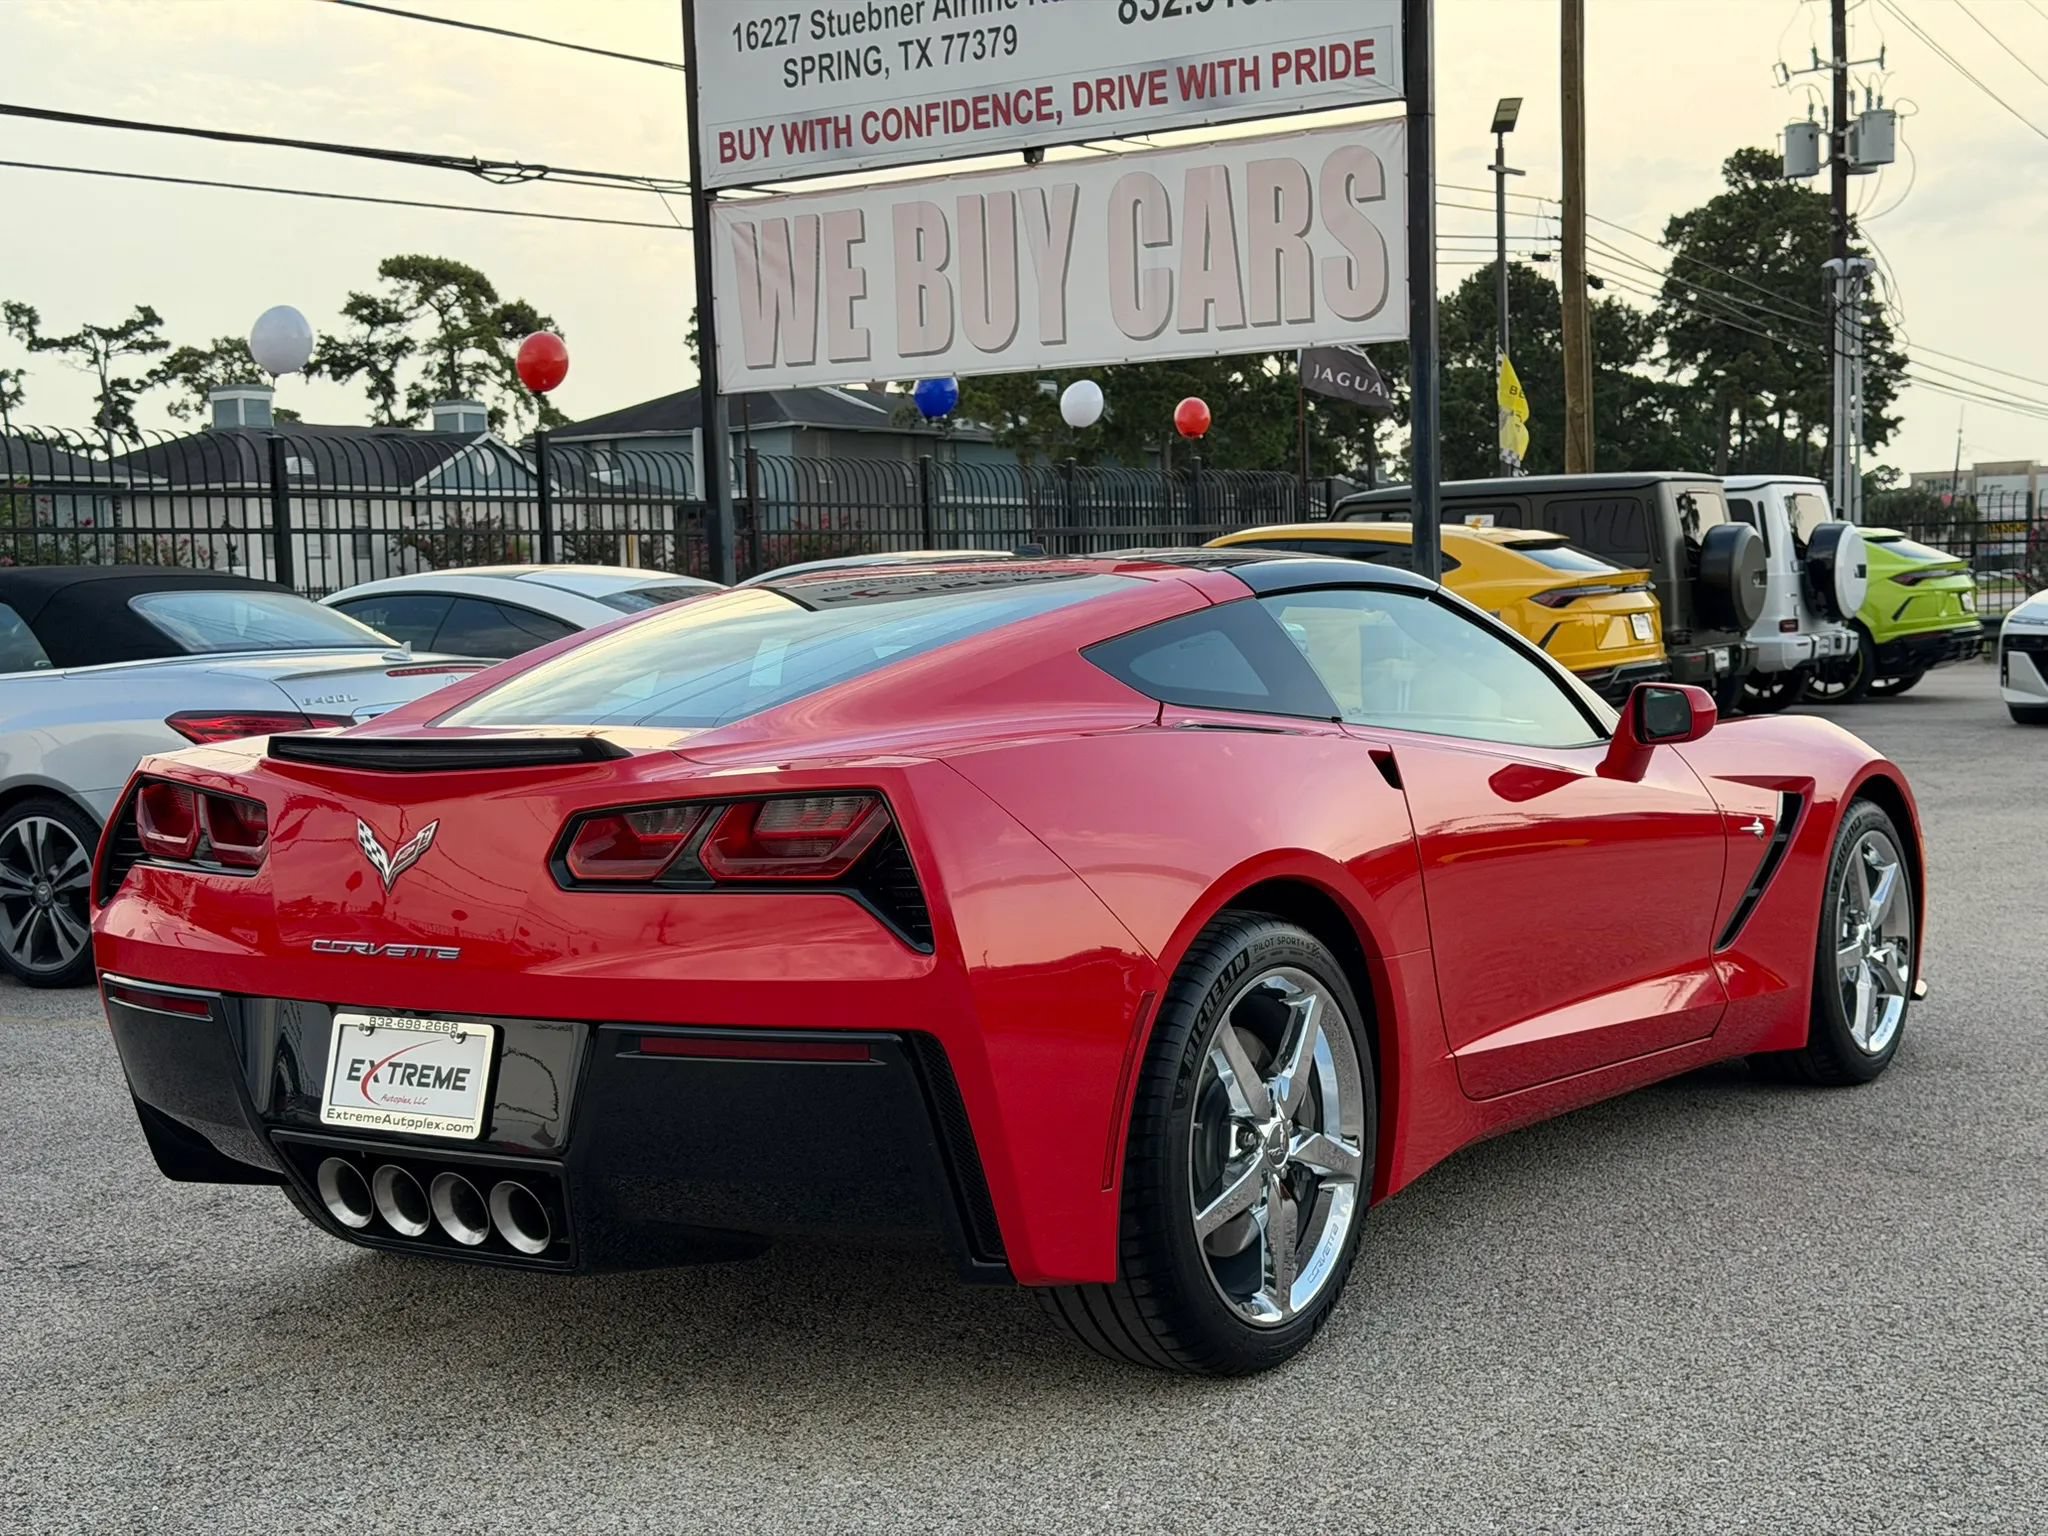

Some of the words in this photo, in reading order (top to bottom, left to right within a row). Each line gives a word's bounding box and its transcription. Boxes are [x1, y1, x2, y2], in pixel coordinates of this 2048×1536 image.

[732, 14, 801, 53] 16227
[810, 0, 926, 41] Stuebner
[783, 45, 890, 88] SPRING,
[898, 37, 933, 71] TX
[941, 24, 1018, 66] 77379
[718, 124, 774, 164] BUY
[780, 114, 853, 156] WITH
[861, 86, 1063, 146] CONFIDENCE,
[1072, 70, 1168, 117] DRIVE
[1177, 56, 1260, 101] WITH
[1271, 39, 1375, 88] PRIDE
[731, 208, 870, 369] WE
[892, 184, 1080, 358] BUY
[1108, 145, 1390, 342] CARS
[312, 939, 461, 960] CORVETTE
[1254, 938, 1274, 953] PILOT
[1277, 937, 1300, 946] SPORT
[1183, 953, 1247, 1070] MICHELIN
[346, 1058, 471, 1092] EXTREME
[413, 1096, 429, 1105] LLC
[326, 1108, 474, 1134] ExtremeAutoplex.com
[1307, 1223, 1339, 1284] CORVETTE
